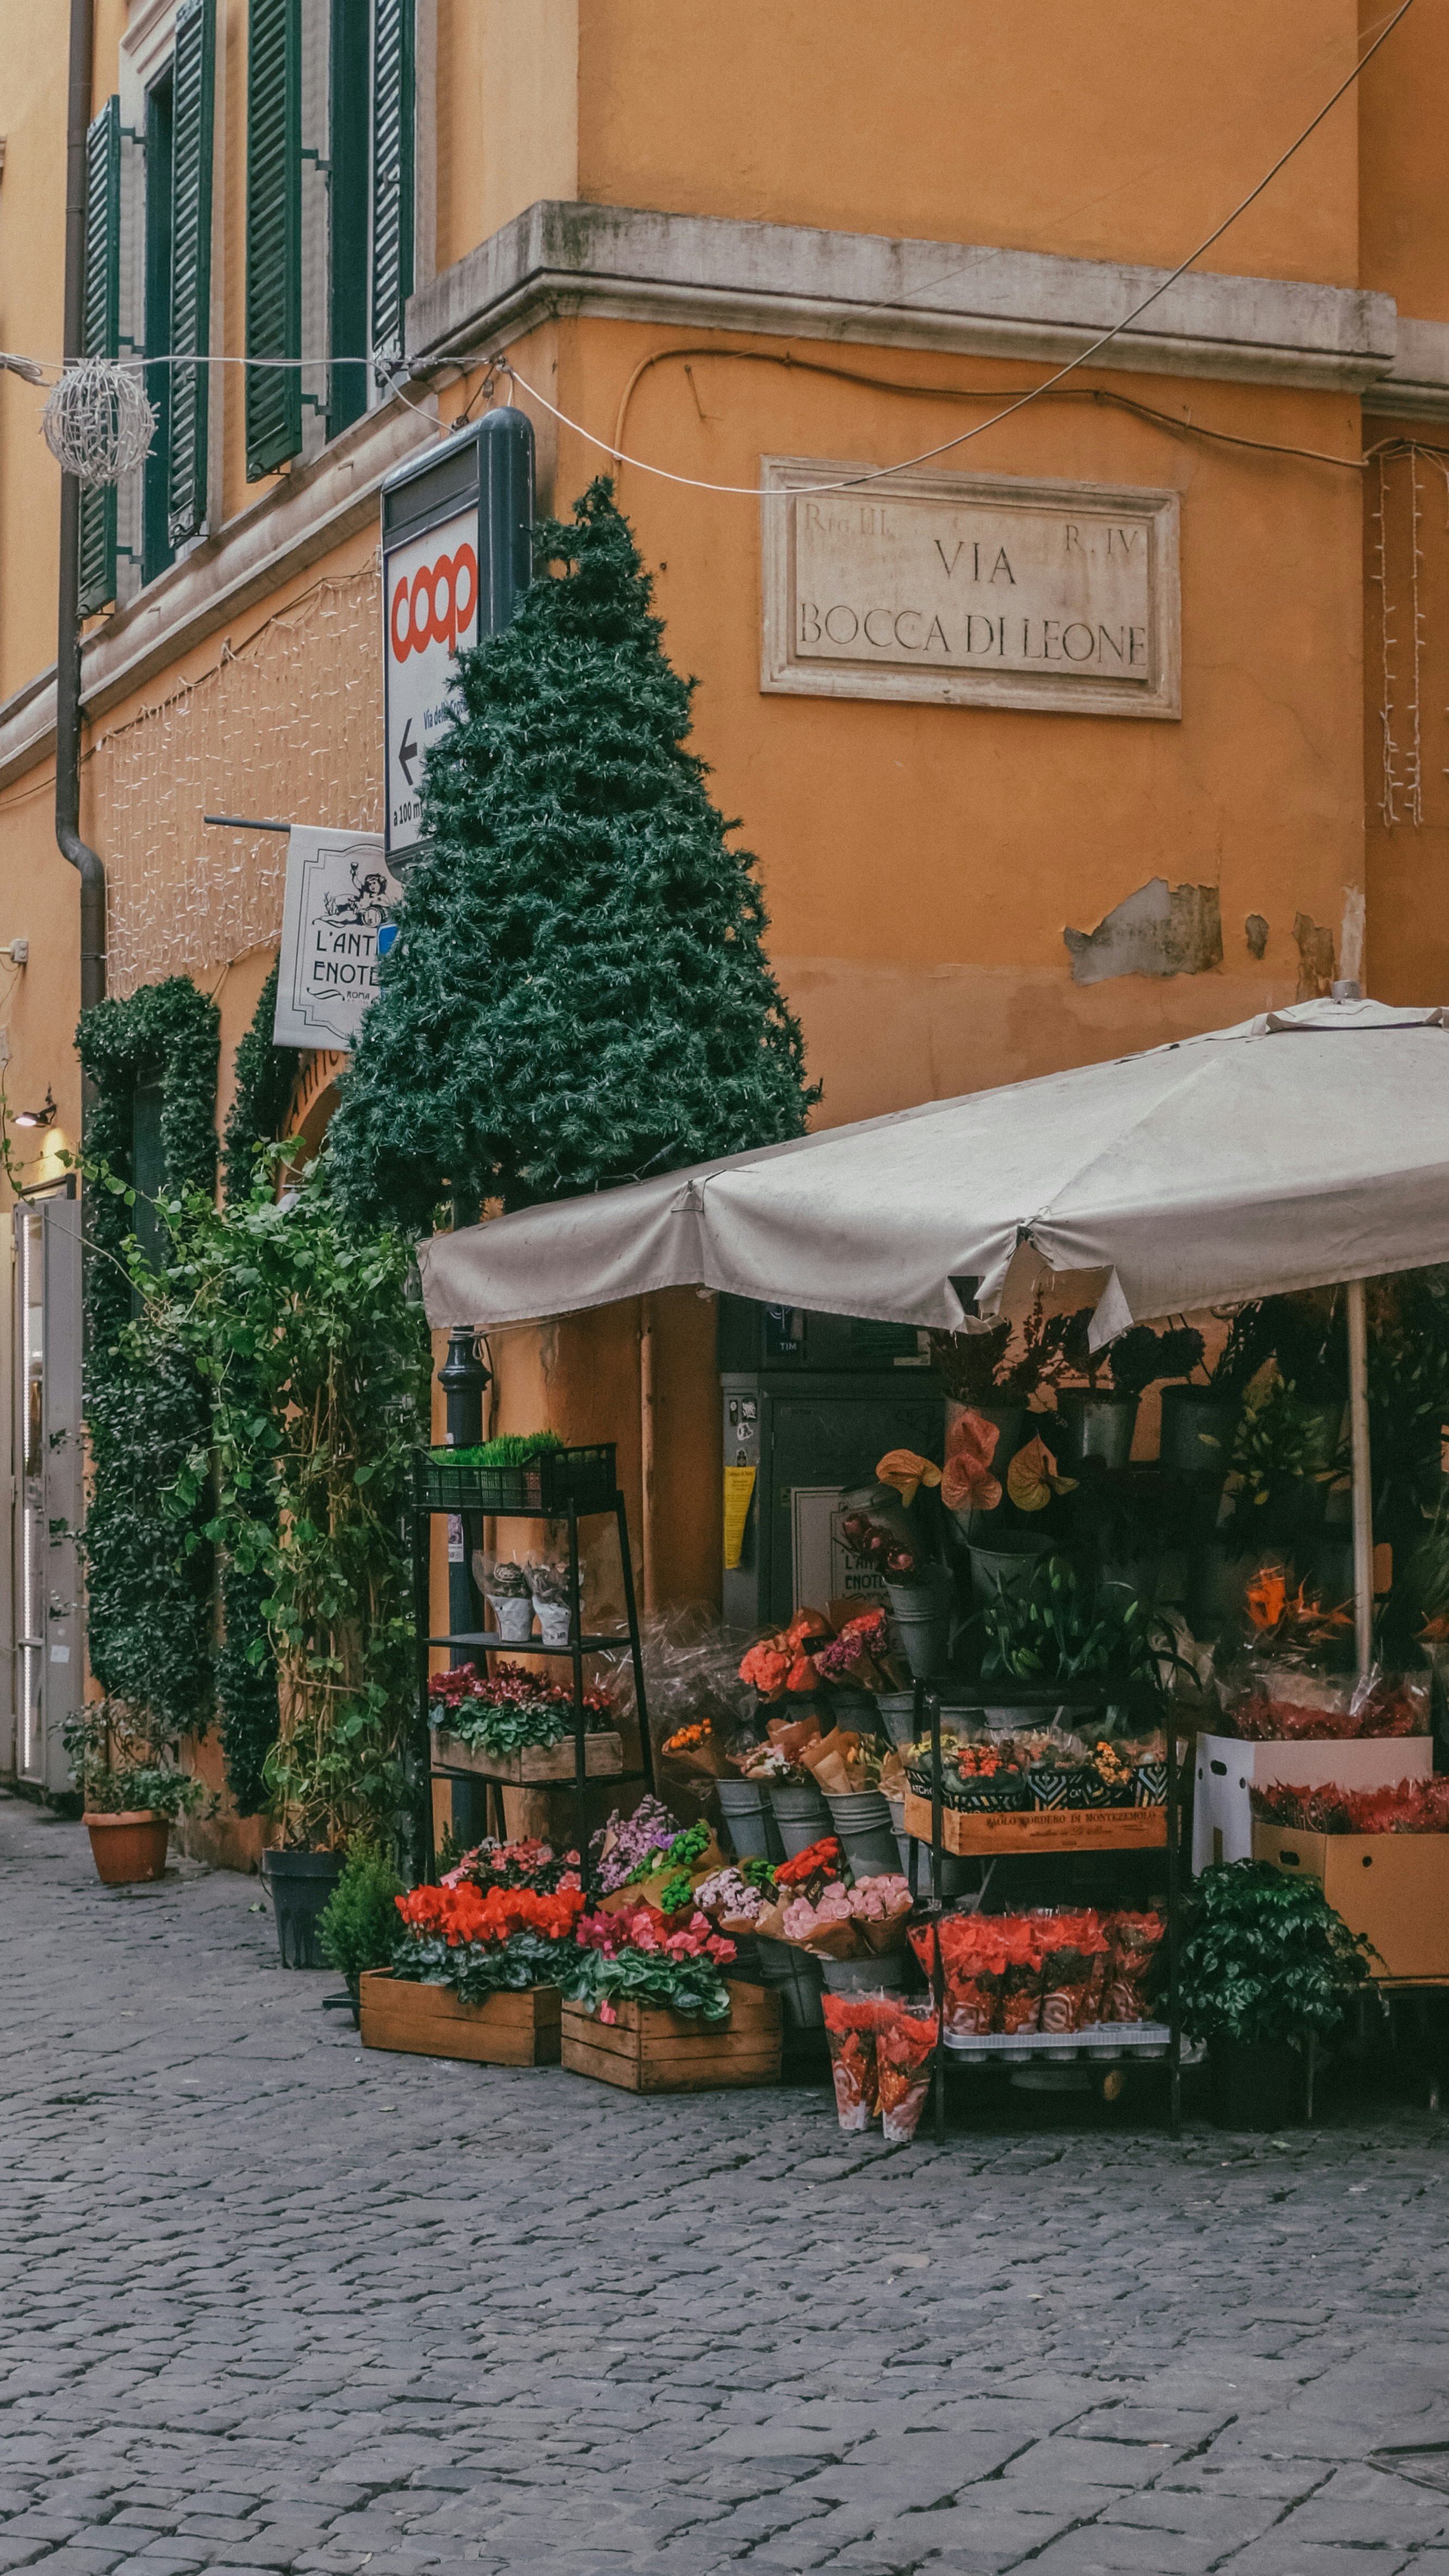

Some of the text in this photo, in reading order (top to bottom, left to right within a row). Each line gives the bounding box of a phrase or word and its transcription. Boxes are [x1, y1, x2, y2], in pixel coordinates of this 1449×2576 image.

[934, 539, 1016, 585] VIA
[391, 543, 478, 664] coop
[801, 602, 1146, 667] BOCCA DI LEONE
[424, 708, 433, 730] Via
[394, 811, 398, 827] a
[399, 801, 412, 825] 100
[316, 930, 376, 957] L'ANT
[313, 960, 380, 987] ENOTE
[347, 991, 370, 1000] ROMA
[779, 1342, 797, 1351] TIM
[1019, 1814, 1066, 1825] ORDERO
